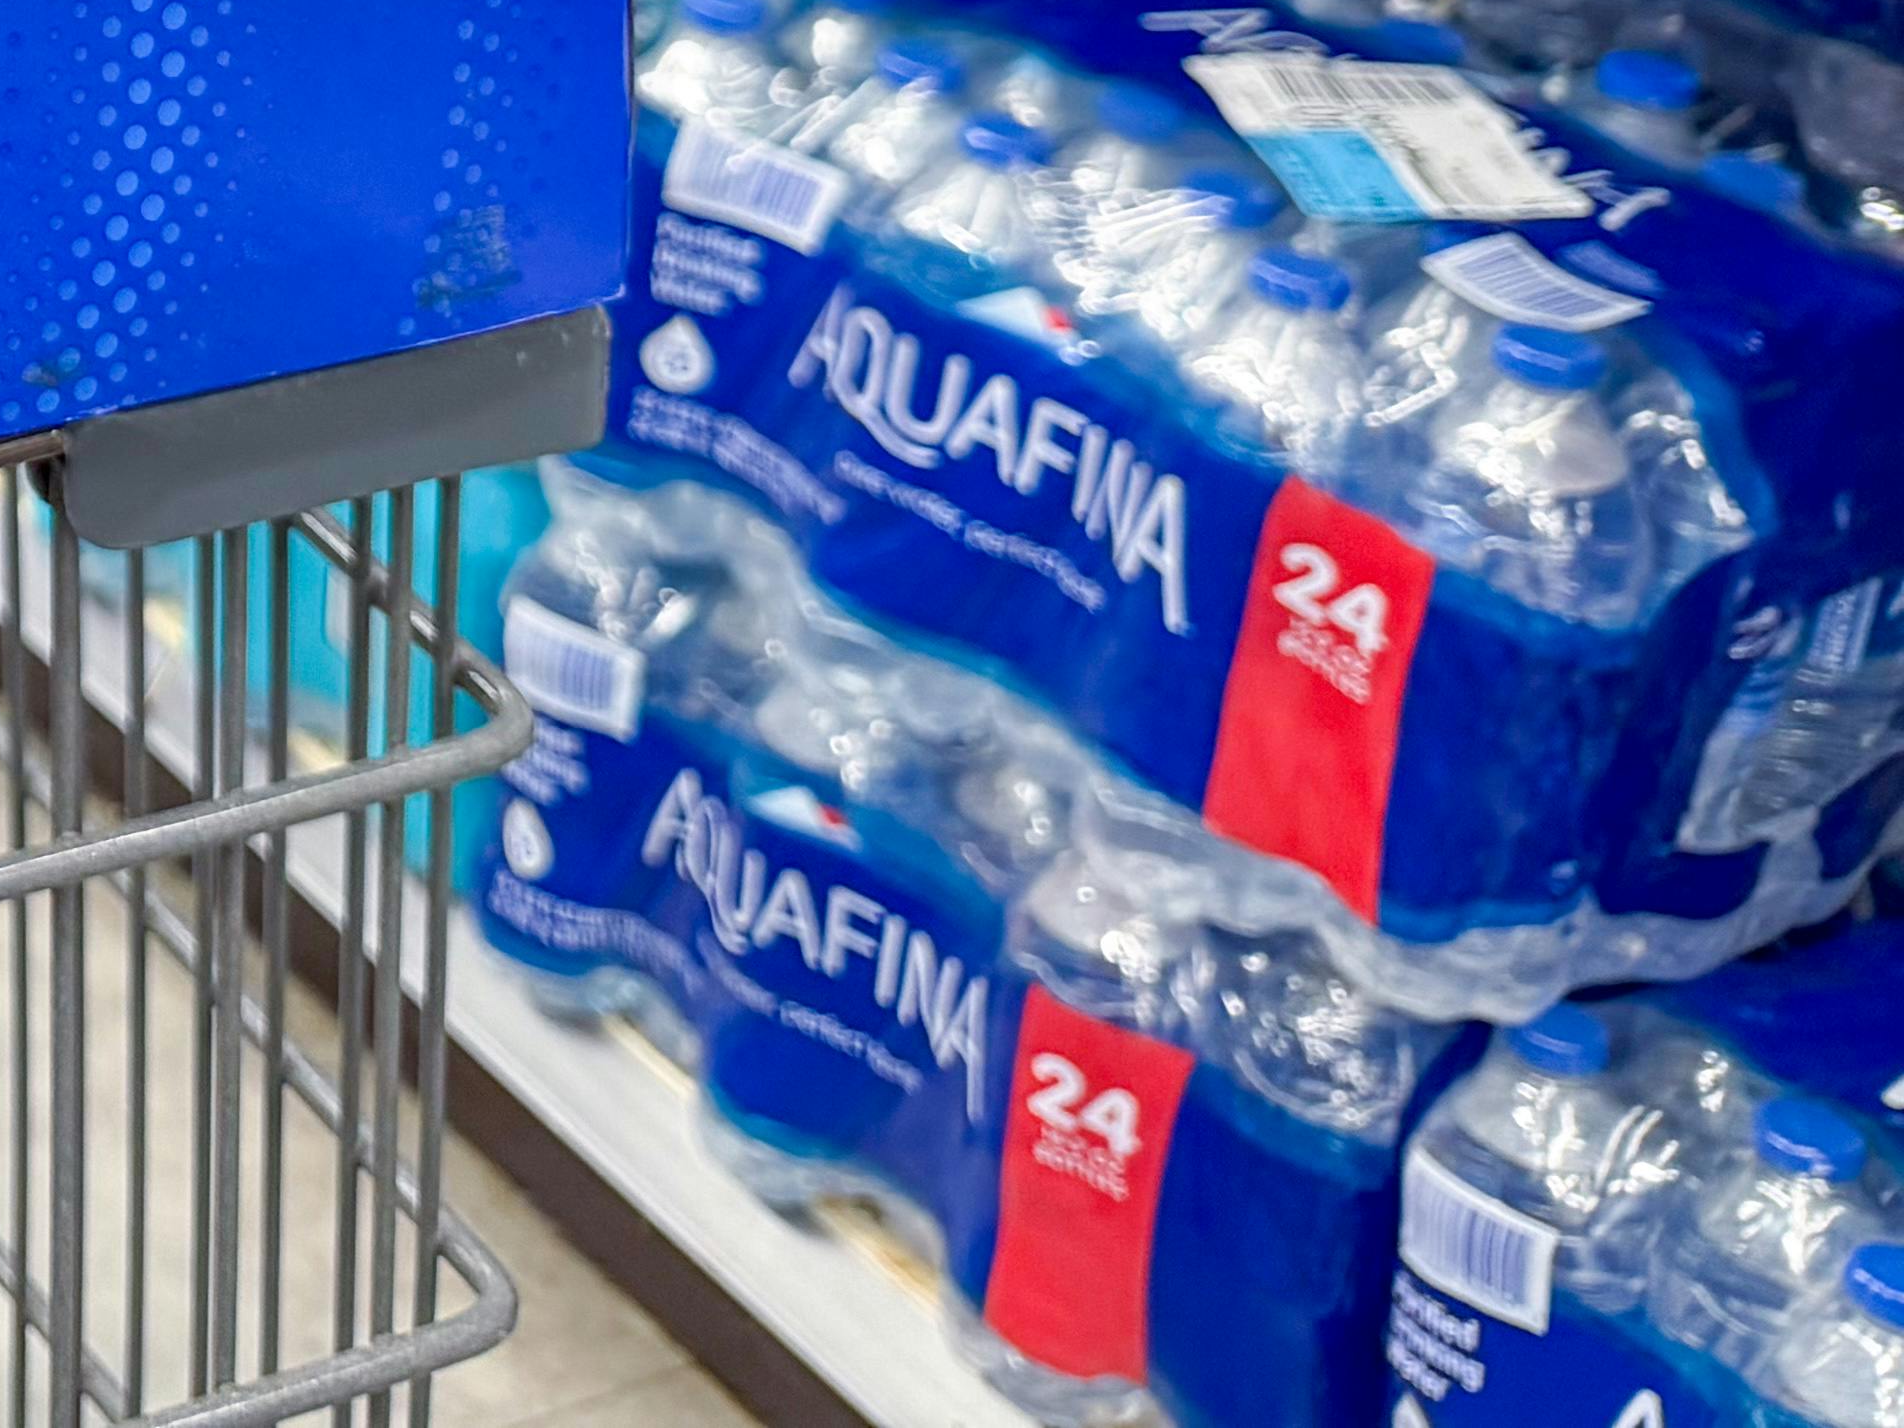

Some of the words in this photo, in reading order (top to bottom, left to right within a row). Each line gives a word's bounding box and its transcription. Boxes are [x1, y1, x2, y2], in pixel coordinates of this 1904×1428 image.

[788, 281, 1189, 638] AQUAFINA
[1272, 541, 1392, 654] 24
[643, 767, 989, 1123] AQUAFINA
[1026, 1053, 1143, 1157] 24
